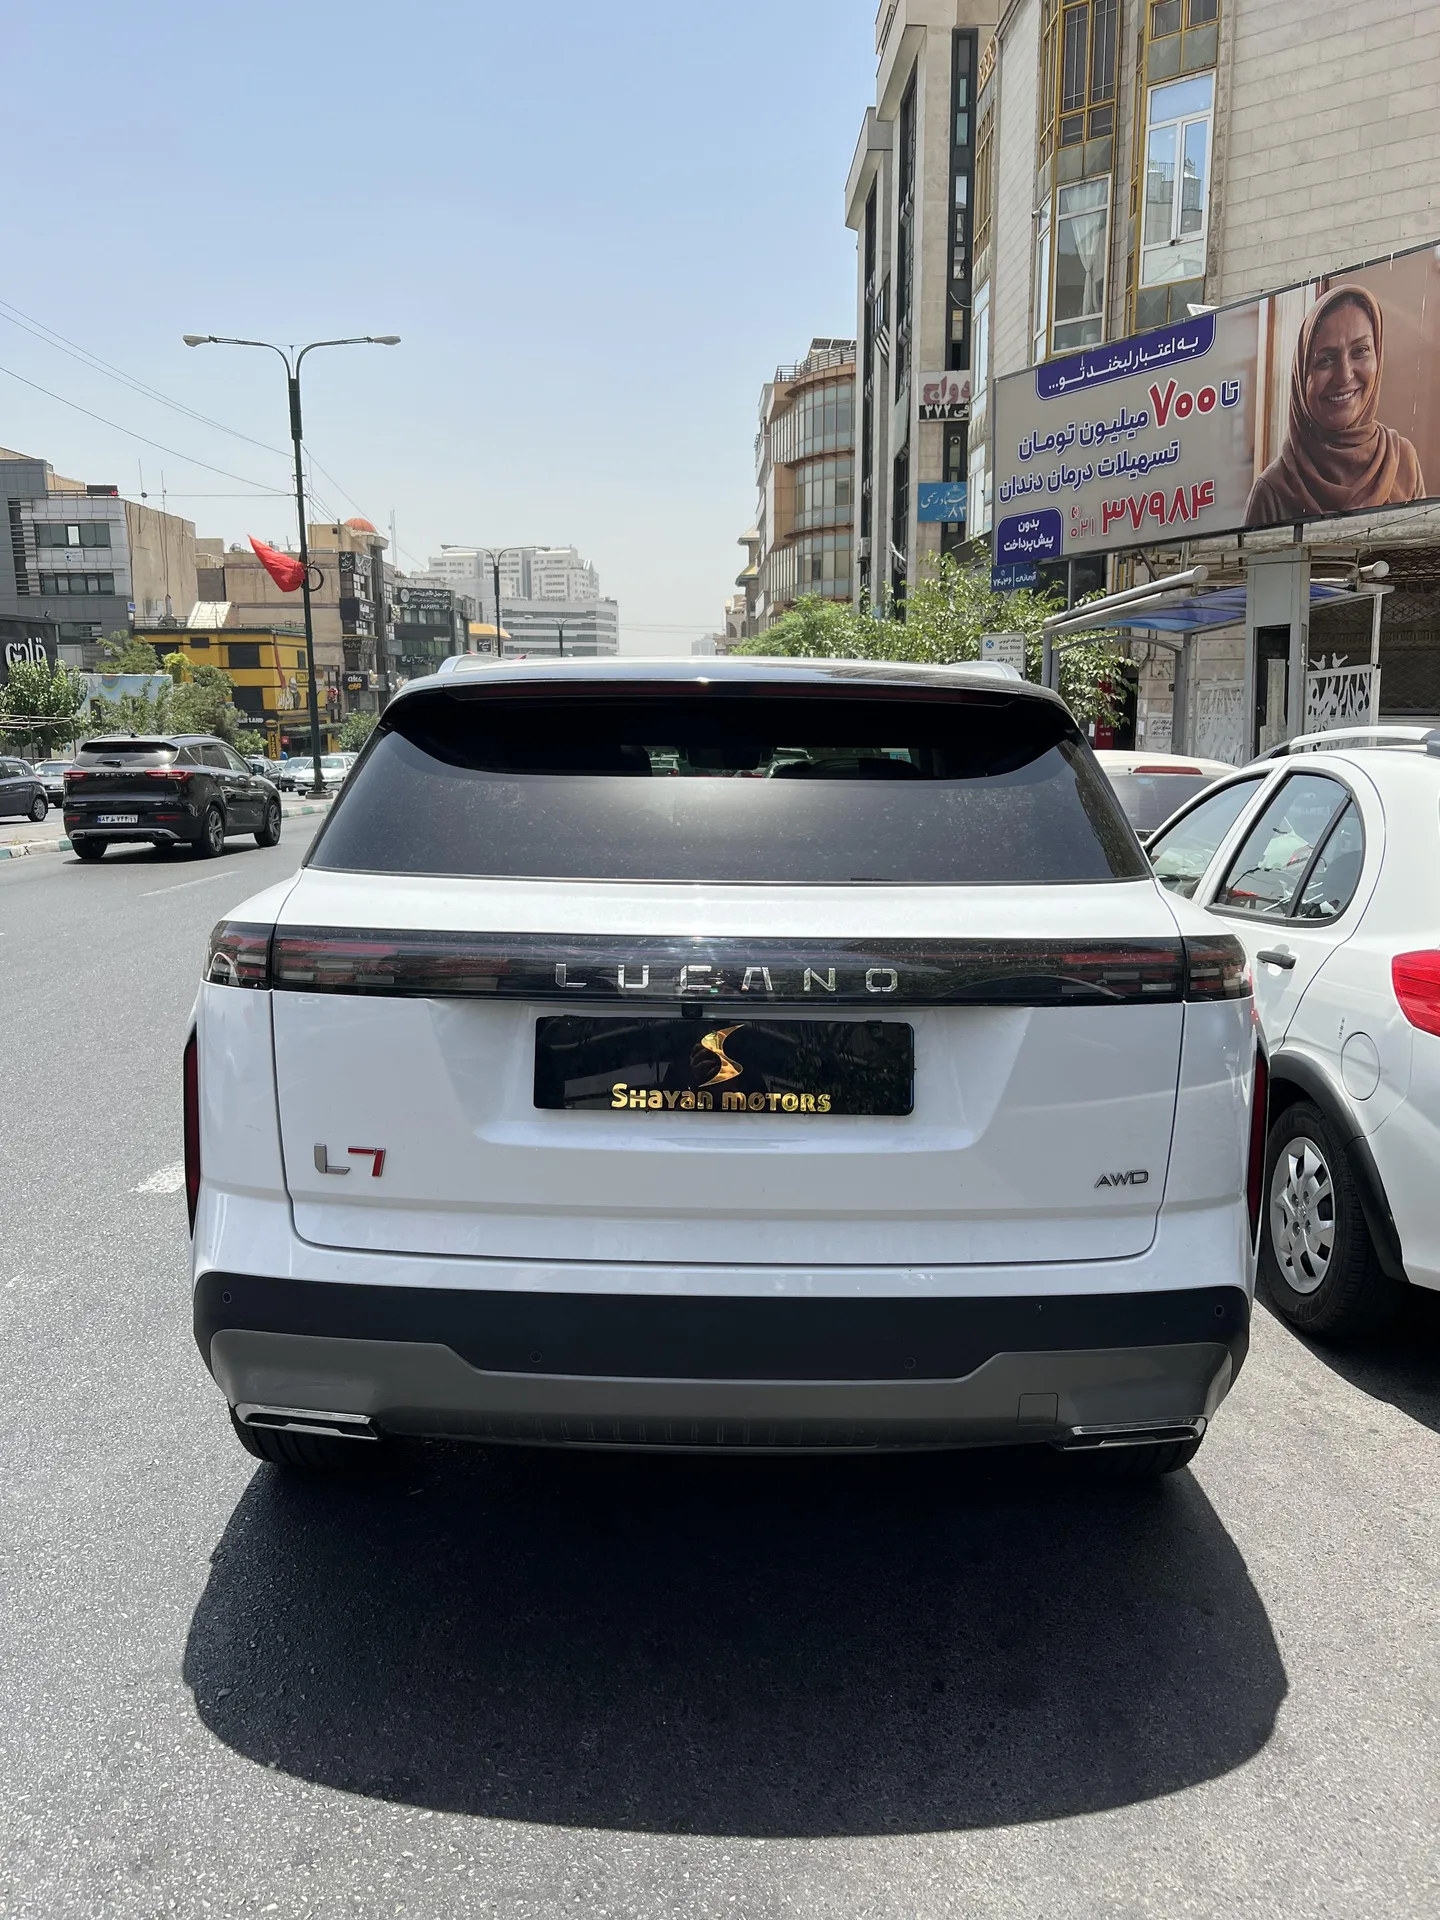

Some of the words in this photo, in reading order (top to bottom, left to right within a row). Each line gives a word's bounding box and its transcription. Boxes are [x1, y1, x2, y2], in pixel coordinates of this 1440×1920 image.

[1133, 337, 1175, 369] اعتبار
[1177, 336, 1199, 353] به
[1086, 350, 1132, 379] لبخند
[1148, 378, 1217, 429] ۷۰۰
[1220, 379, 1240, 408] تا
[1018, 422, 1075, 460] تومان
[1079, 407, 1149, 448] میلیون
[1097, 440, 1180, 479] تسهیلات
[999, 473, 1044, 504] دندان
[1047, 462, 1093, 494] درمان
[1070, 517, 1095, 538] ۰۲۱
[1101, 479, 1215, 535] ۳۷۹۸۴
[1017, 519, 1040, 533] بدون
[1015, 571, 1037, 583] آرمانی
[555, 963, 899, 993] LUCANO
[313, 1143, 386, 1177] L7
[1094, 1168, 1149, 1188] AWD
